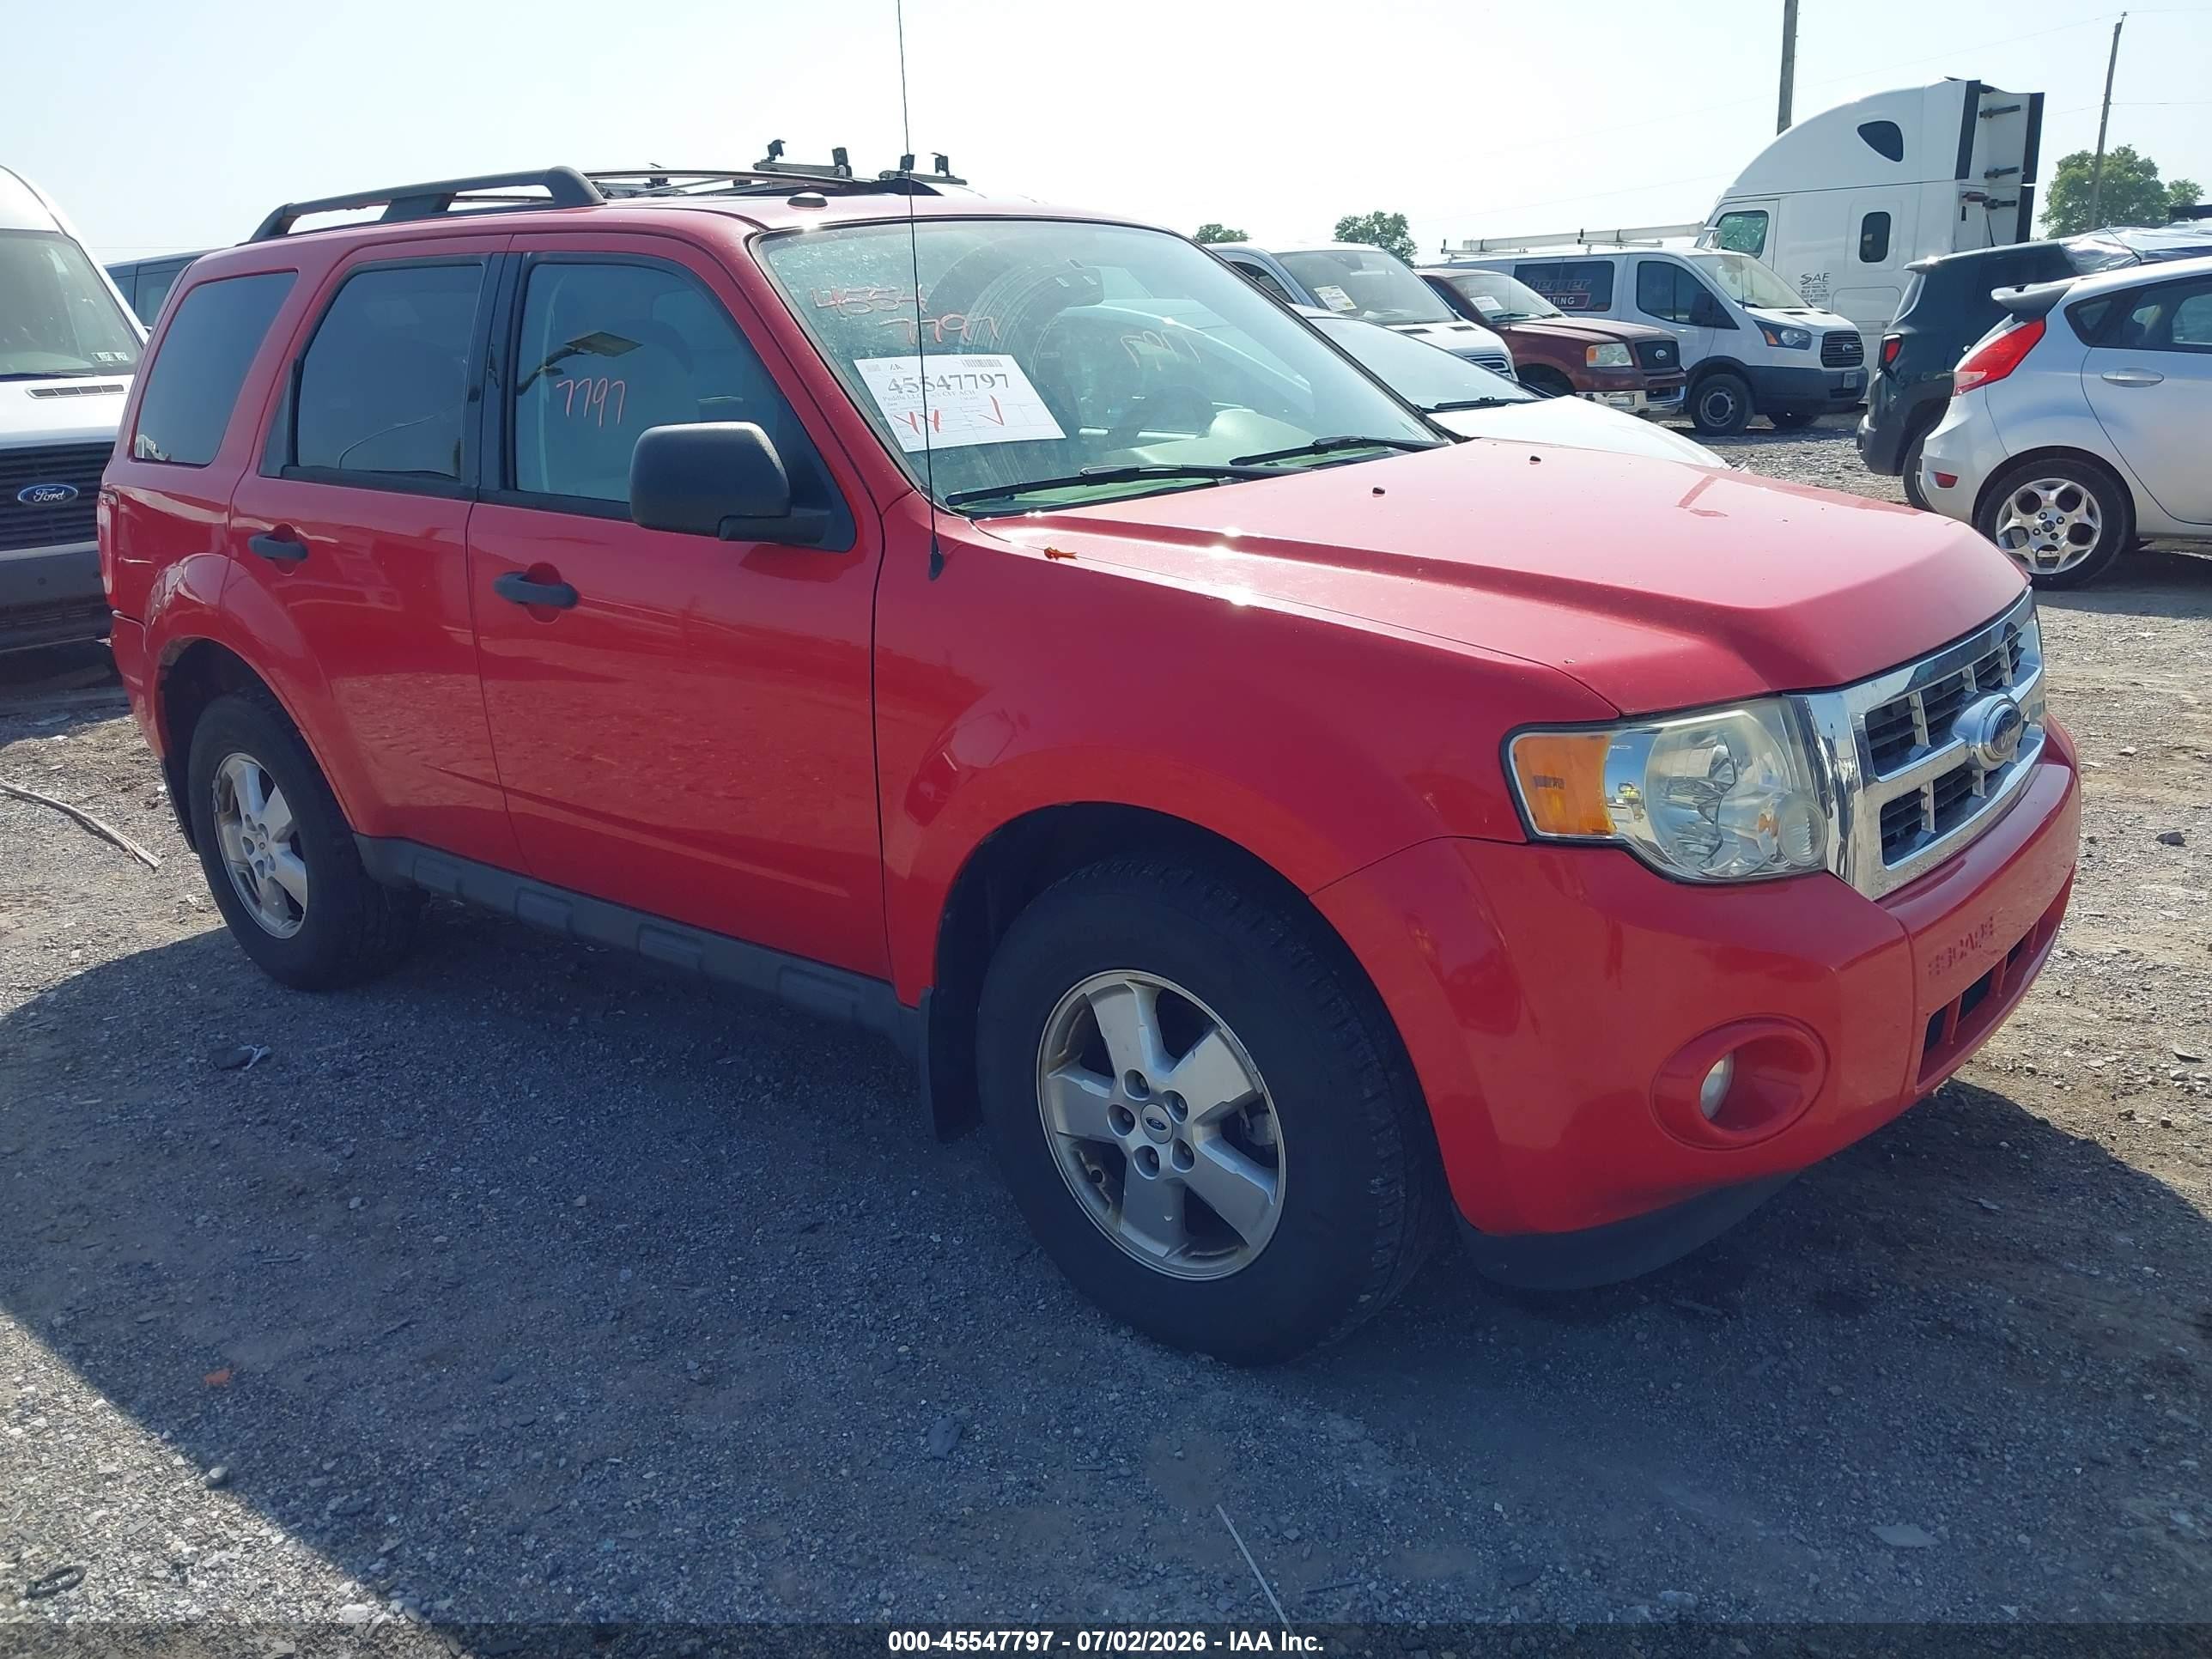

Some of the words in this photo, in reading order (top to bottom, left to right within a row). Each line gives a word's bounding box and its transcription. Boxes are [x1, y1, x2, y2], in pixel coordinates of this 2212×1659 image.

[1800, 272, 1831, 285] SAE
[878, 313, 1001, 344] 7797
[888, 373, 1009, 394] 45547797
[556, 378, 626, 427] 7797
[33, 487, 66, 502] Ford
